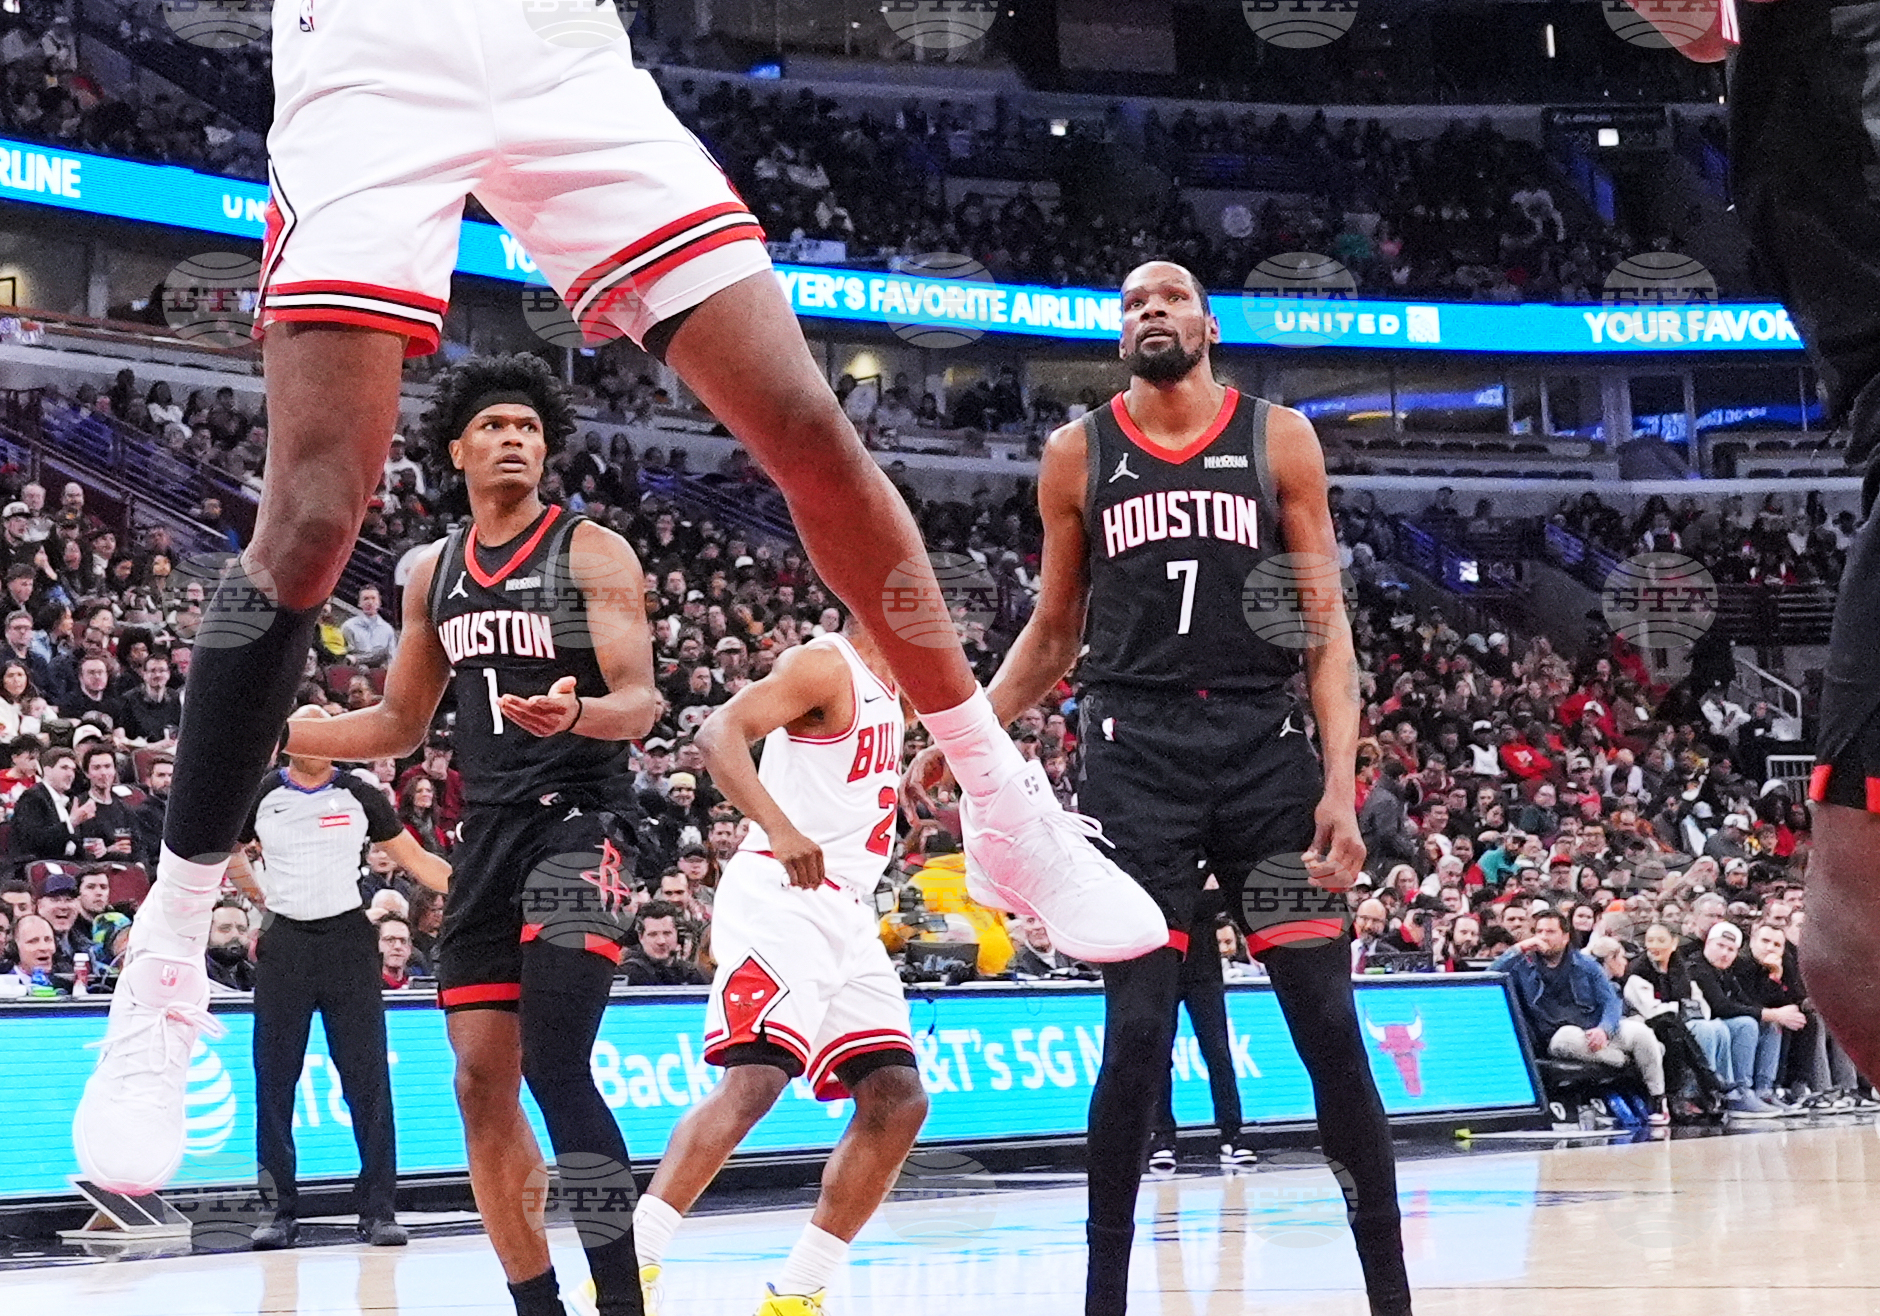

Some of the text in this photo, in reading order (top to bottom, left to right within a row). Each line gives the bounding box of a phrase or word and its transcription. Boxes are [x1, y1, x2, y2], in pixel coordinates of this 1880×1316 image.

[870, 278, 1008, 323] FAVORITE
[1011, 291, 1122, 331] AIRLINE
[1274, 310, 1400, 335] UNITED
[1583, 310, 1684, 343] YOUR
[1102, 490, 1259, 559] HOUSTON
[1166, 559, 1199, 635] 7
[438, 609, 556, 665] HOUSTON
[482, 667, 504, 735] 1
[1011, 1025, 1077, 1090] 5G
